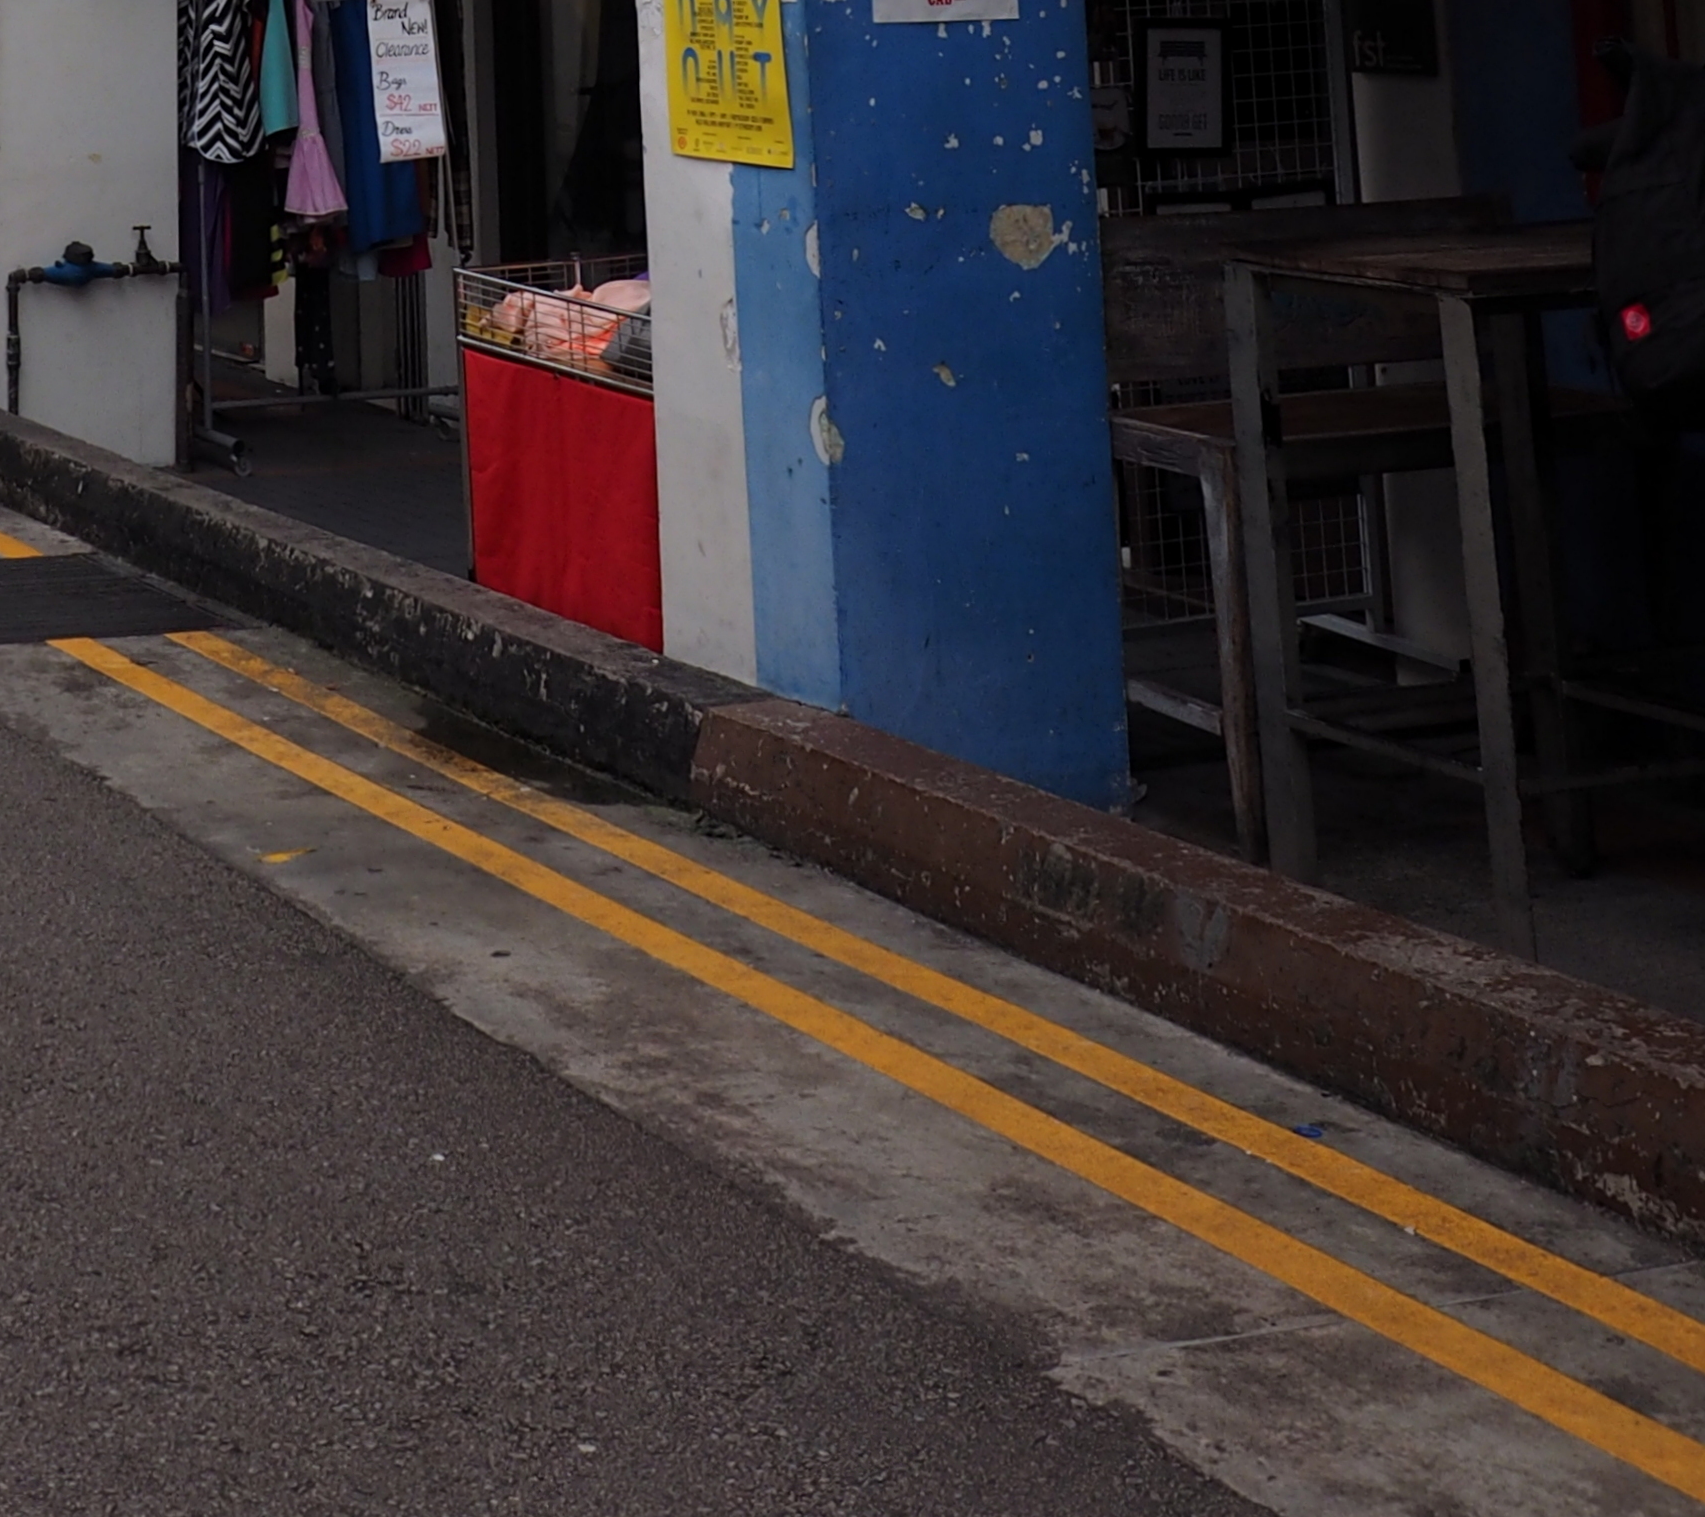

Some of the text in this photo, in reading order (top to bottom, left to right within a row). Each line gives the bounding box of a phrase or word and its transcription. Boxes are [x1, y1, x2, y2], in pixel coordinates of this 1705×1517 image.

[372, 2, 408, 22] Brand
[375, 42, 430, 58] Clearance
[1353, 30, 1387, 67] fst
[377, 71, 407, 90] Bags
[385, 94, 412, 112] $42
[390, 139, 422, 157] $22
